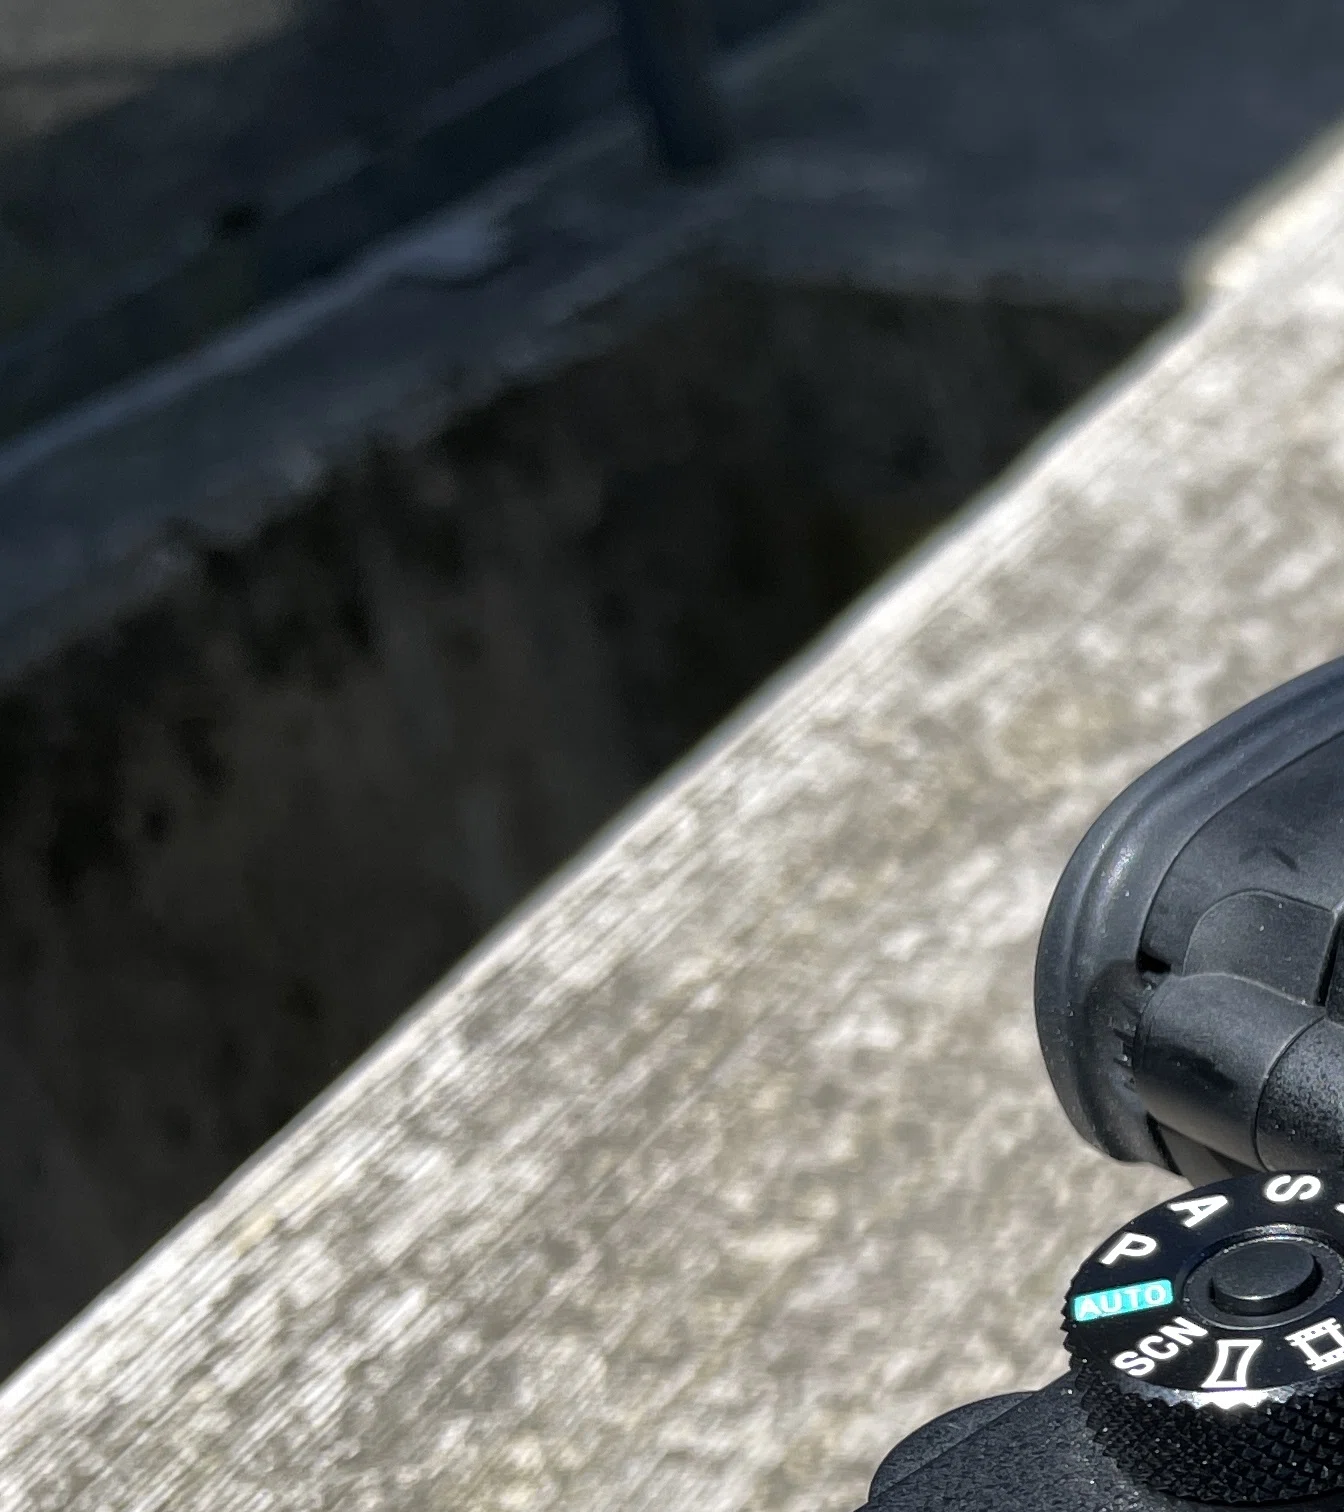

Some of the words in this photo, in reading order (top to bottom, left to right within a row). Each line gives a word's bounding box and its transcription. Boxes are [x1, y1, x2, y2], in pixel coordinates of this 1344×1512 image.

[1264, 1174, 1322, 1203] S
[1168, 1194, 1229, 1229] A
[1101, 1232, 1157, 1265] P
[1075, 1282, 1168, 1321] AUTO
[1113, 1316, 1209, 1376] SCN
